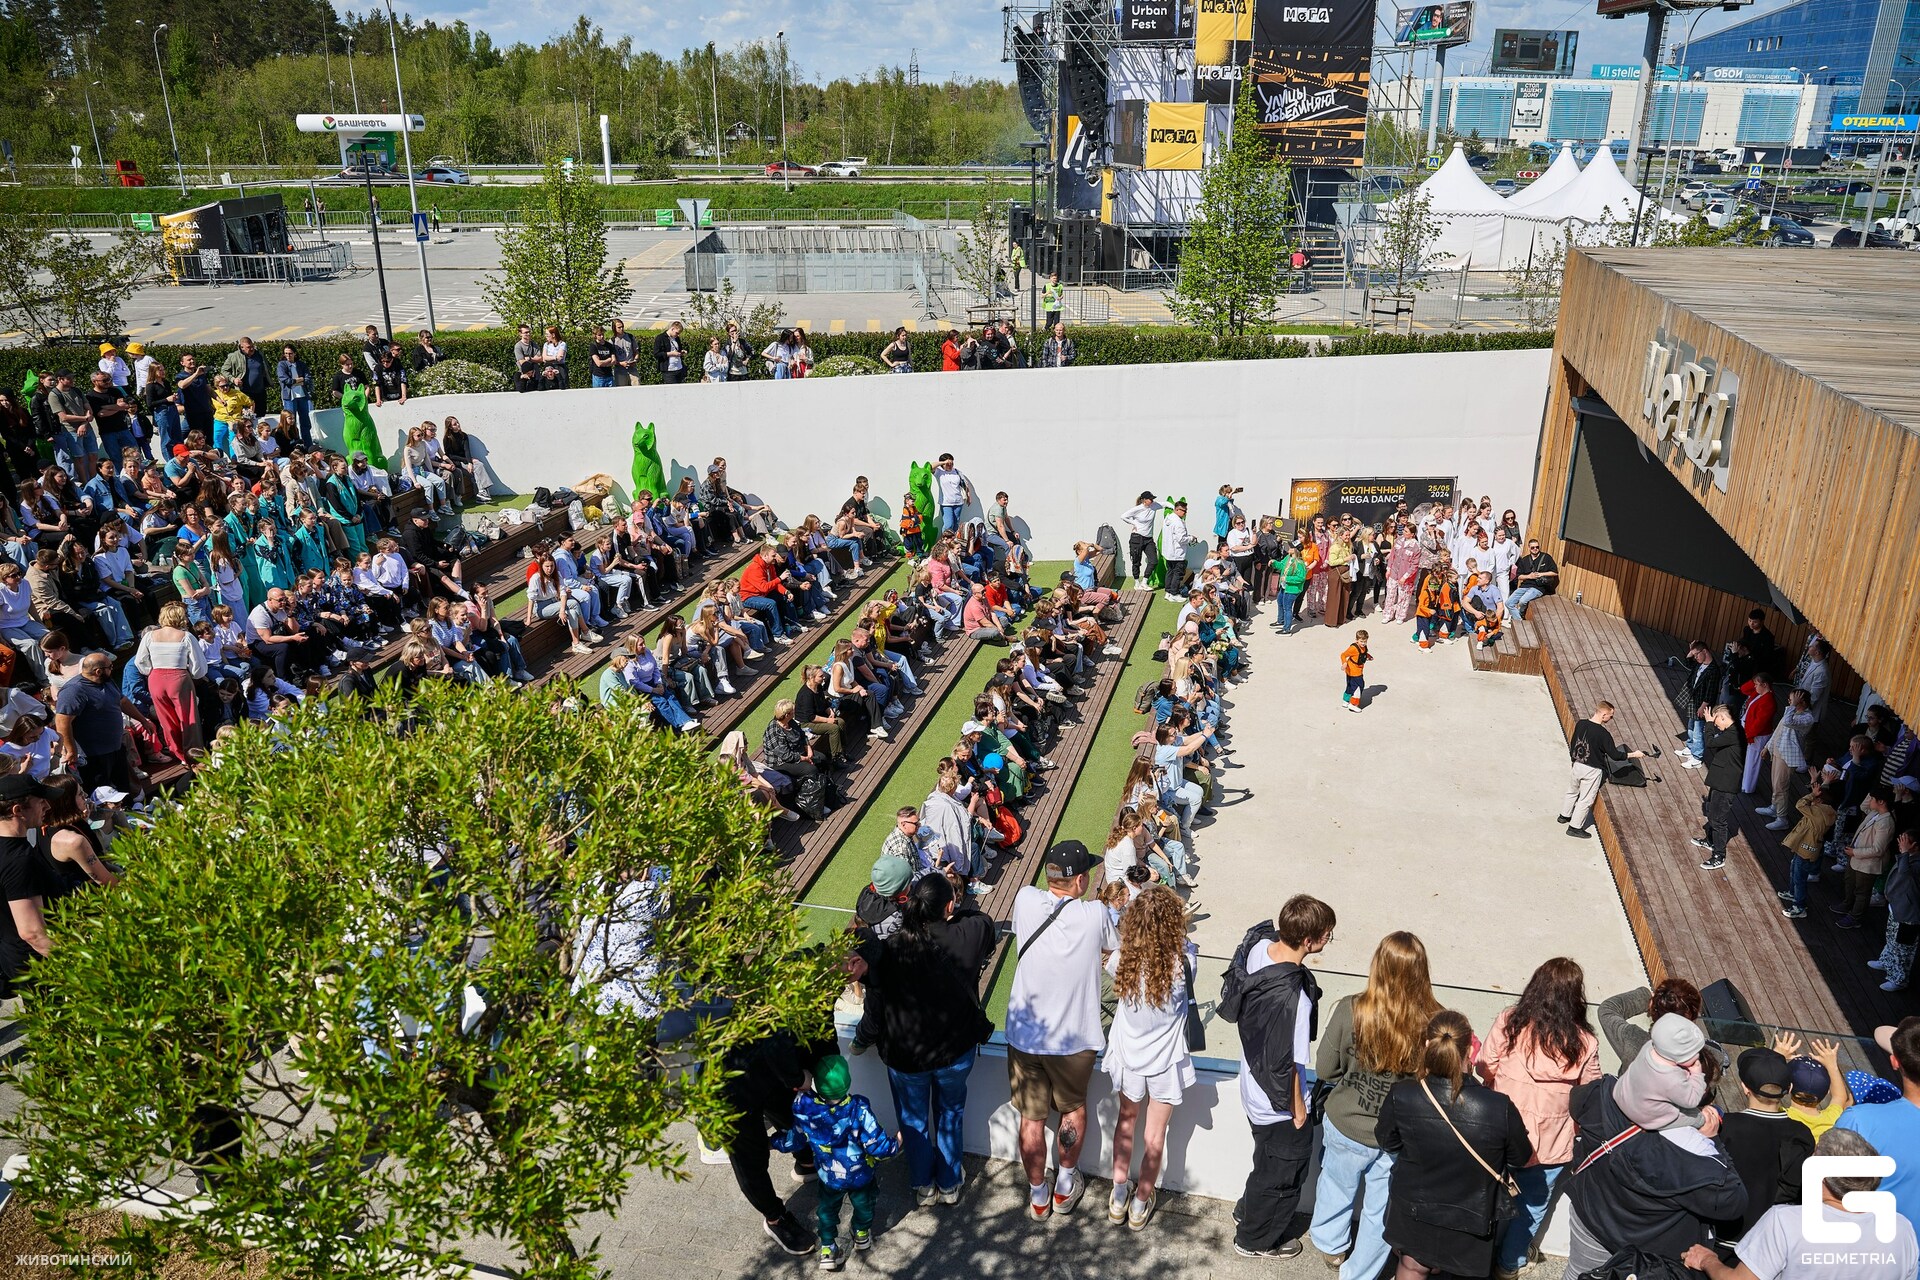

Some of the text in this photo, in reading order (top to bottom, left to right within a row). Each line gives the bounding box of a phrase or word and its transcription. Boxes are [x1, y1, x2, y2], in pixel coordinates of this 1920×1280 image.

[1131, 5, 1168, 16] Urban
[1131, 19, 1157, 29] Fest
[1714, 69, 1743, 79] ОБОИ
[1257, 84, 1307, 113] УЛИЦЫ
[1264, 88, 1338, 122] ОБЪЕДИНЯЮТ
[338, 120, 387, 128] БАШНЕФТЬ
[1842, 117, 1905, 127] ОТДЕЛКА
[1341, 484, 1407, 495] СОЛНЕЧНЫЙ
[1340, 495, 1405, 504] MEGA DANCE
[1341, 1077, 1365, 1096] THE
[1358, 1096, 1371, 1112] IN
